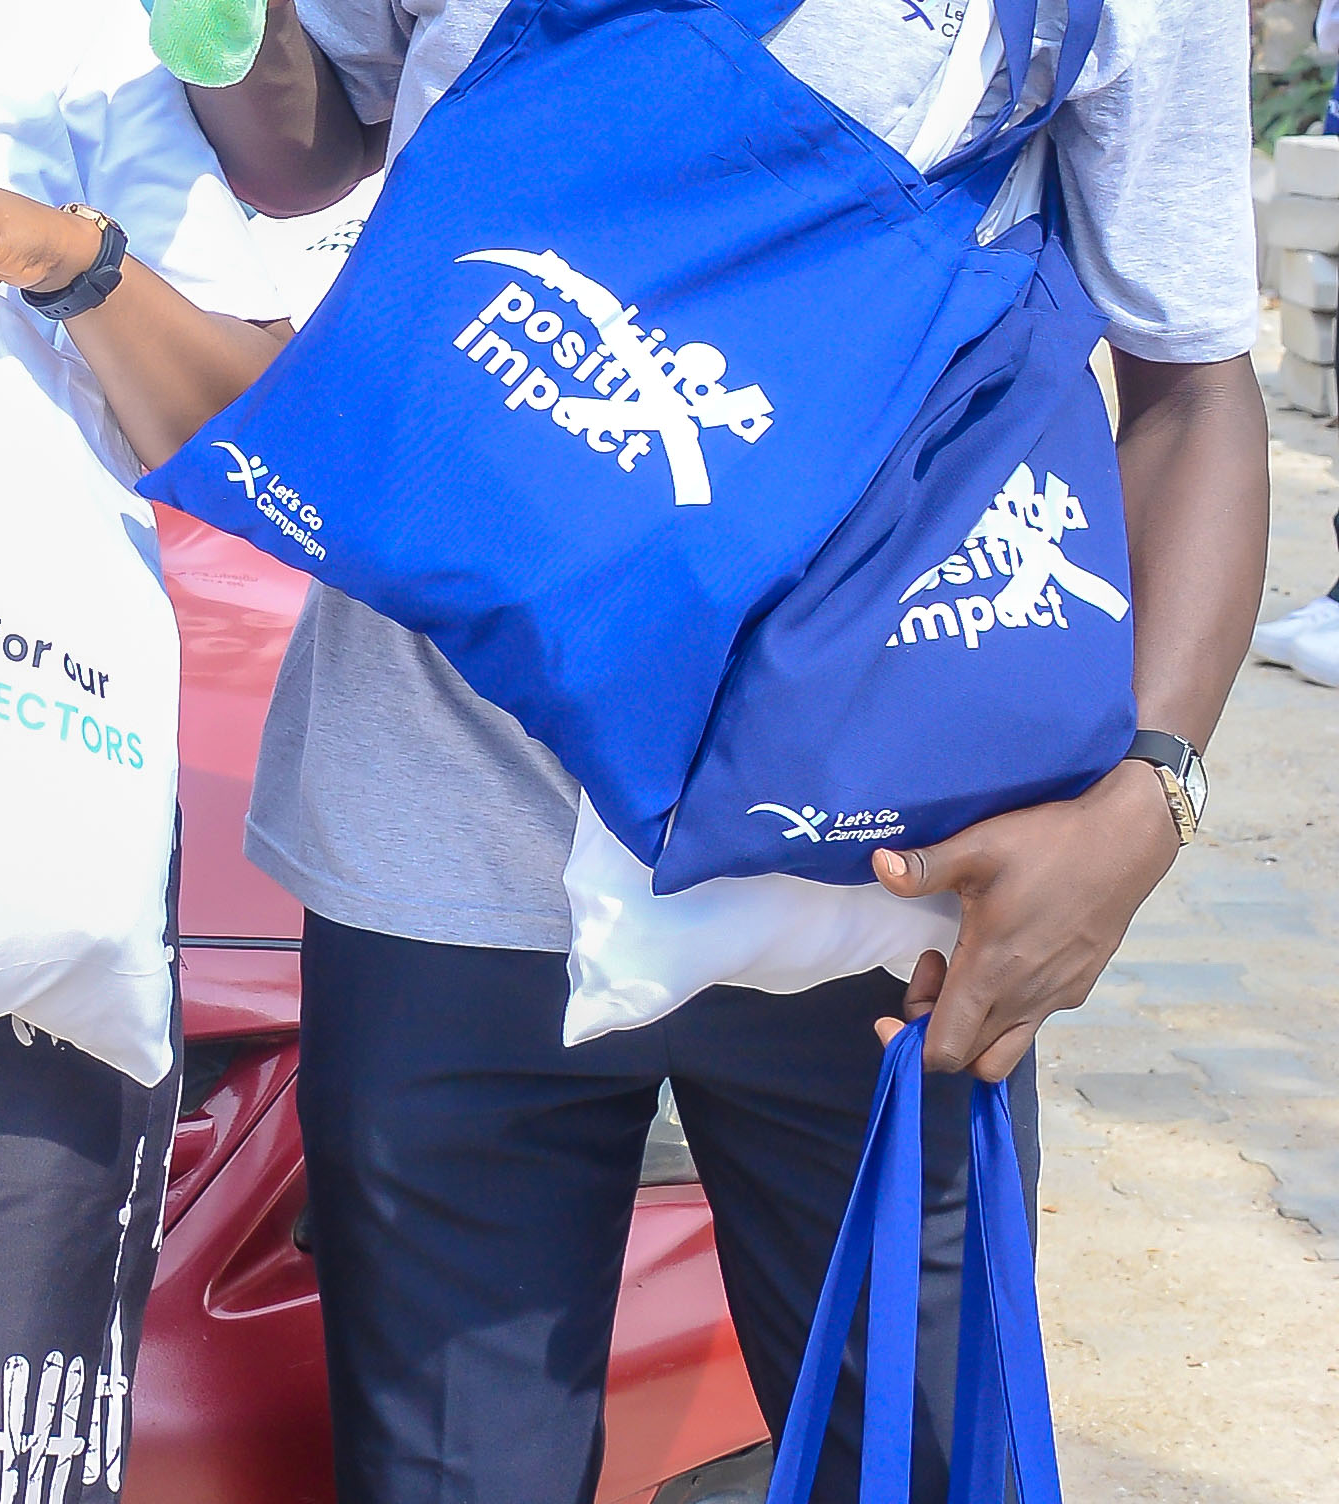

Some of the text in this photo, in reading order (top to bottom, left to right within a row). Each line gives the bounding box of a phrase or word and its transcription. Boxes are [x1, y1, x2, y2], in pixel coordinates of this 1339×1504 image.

[452, 319, 652, 473] impact
[256, 492, 327, 561] Campaign
[266, 474, 323, 531] Let's Go
[886, 585, 1069, 649] mpact
[63, 651, 110, 700] our
[824, 824, 905, 843] Campaign
[833, 809, 900, 828] Let's Go
